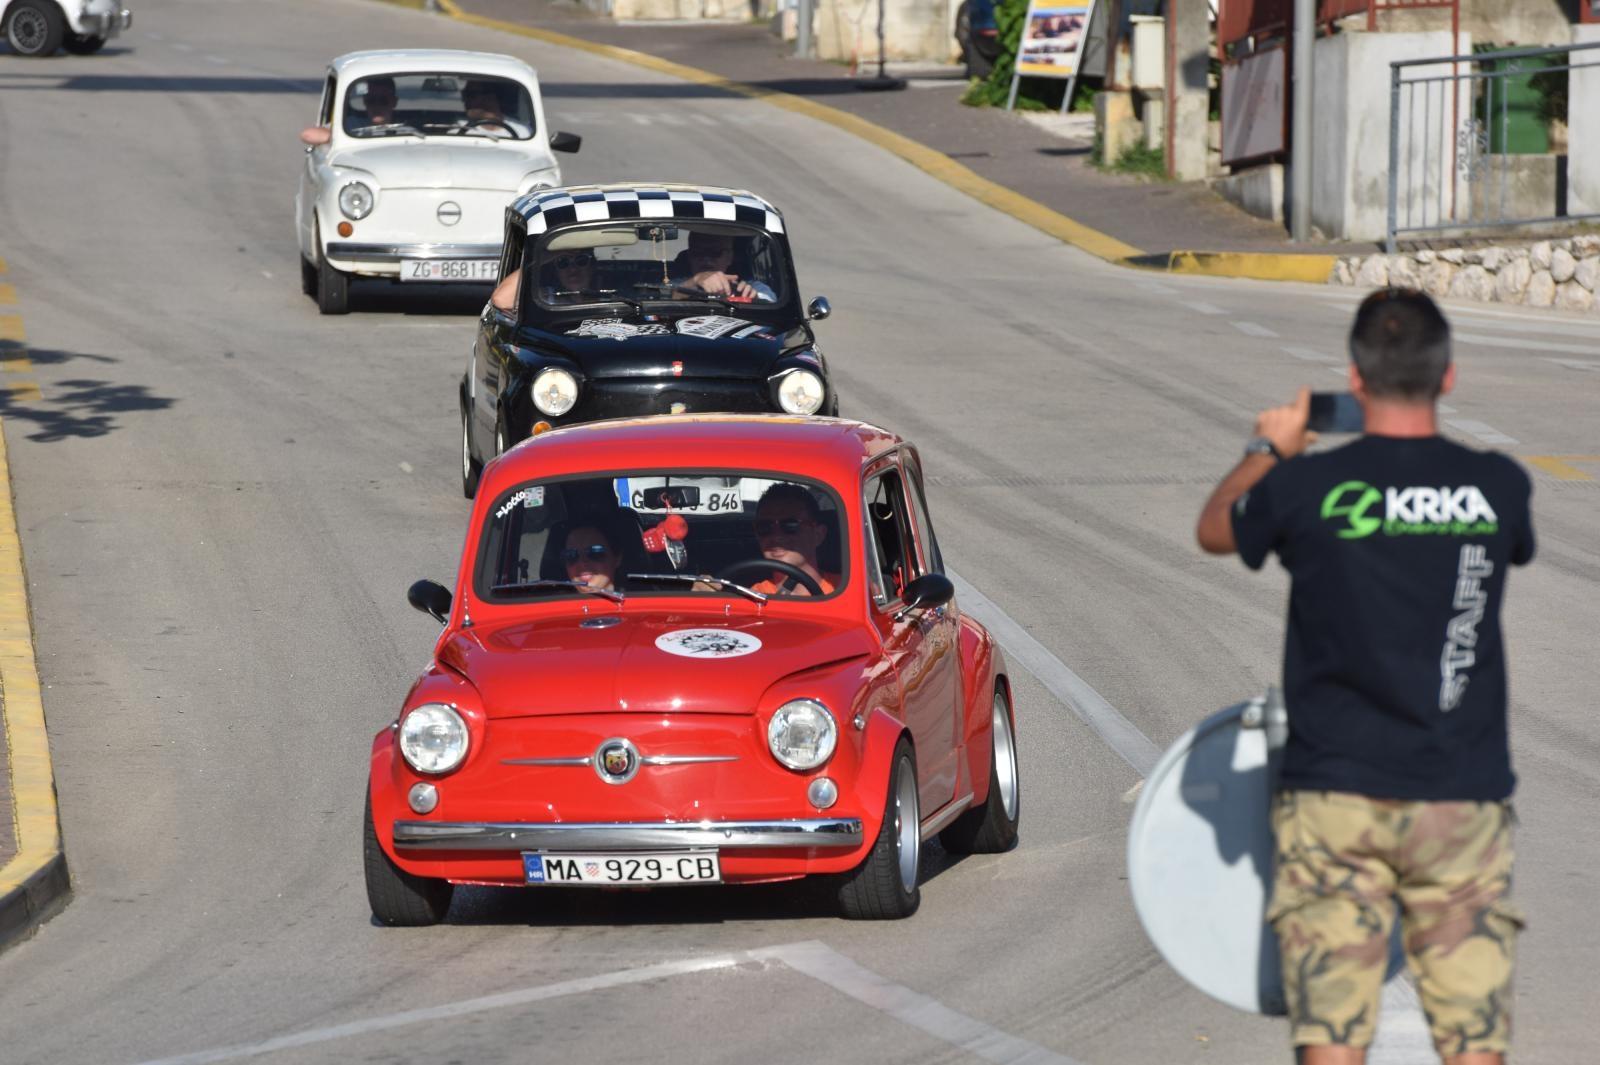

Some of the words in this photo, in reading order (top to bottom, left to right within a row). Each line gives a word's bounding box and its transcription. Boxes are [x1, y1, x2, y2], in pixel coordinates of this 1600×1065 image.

[412, 262, 431, 277] ZG
[1385, 486, 1498, 524] KRKA
[1438, 543, 1494, 713] STAFF
[528, 871, 544, 879] HR
[545, 859, 582, 881] MA
[605, 857, 715, 881] 929-CB
